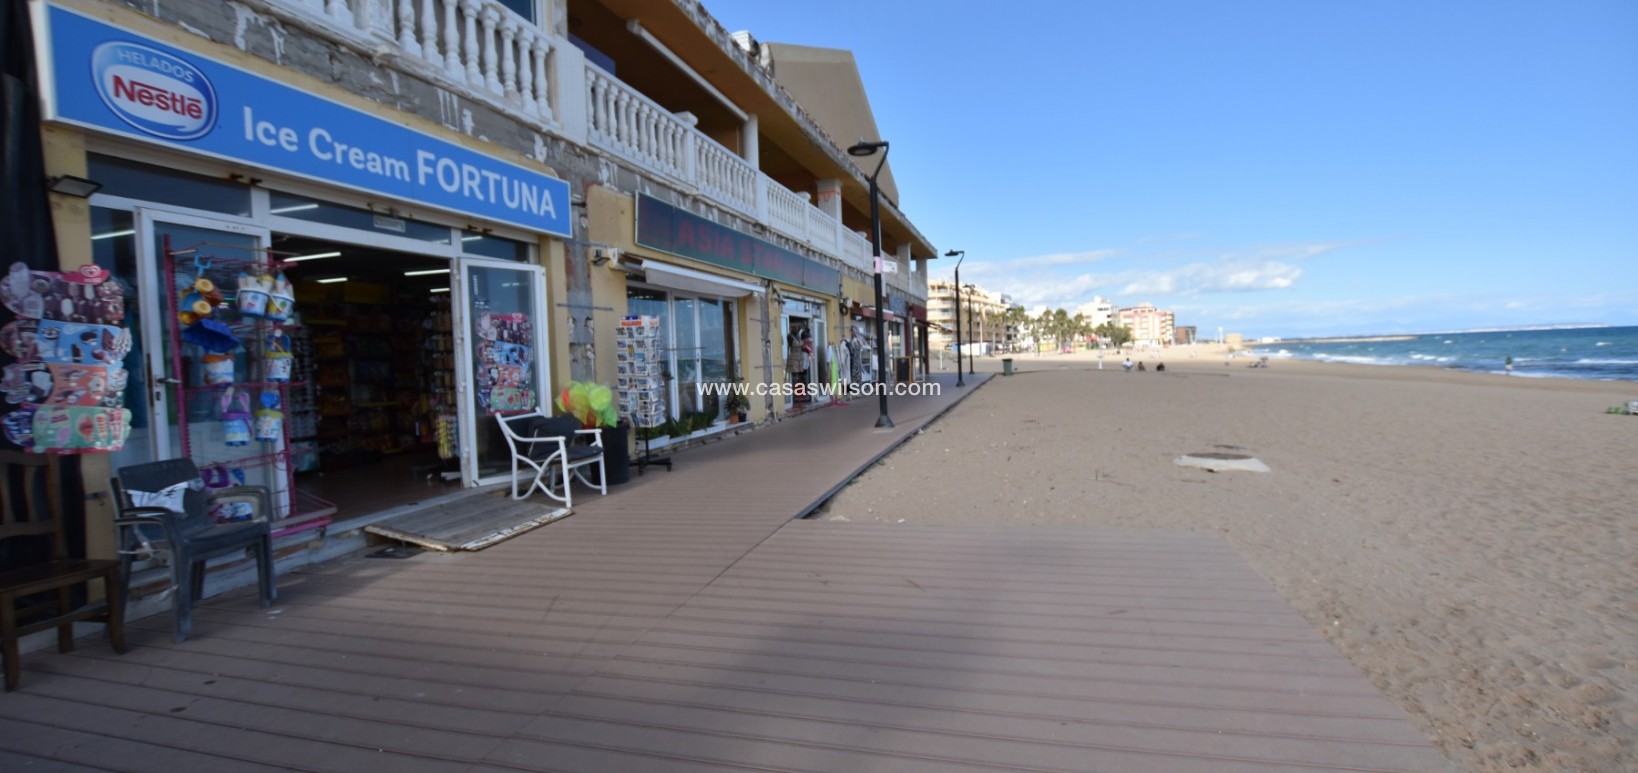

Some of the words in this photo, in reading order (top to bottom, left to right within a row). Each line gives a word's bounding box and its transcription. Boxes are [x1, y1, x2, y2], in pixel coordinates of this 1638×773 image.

[116, 47, 195, 84] HELADOS
[243, 105, 299, 152] Ice
[308, 127, 411, 182] Cream
[416, 149, 556, 220] FORTUNA
[677, 218, 736, 263] ASIA
